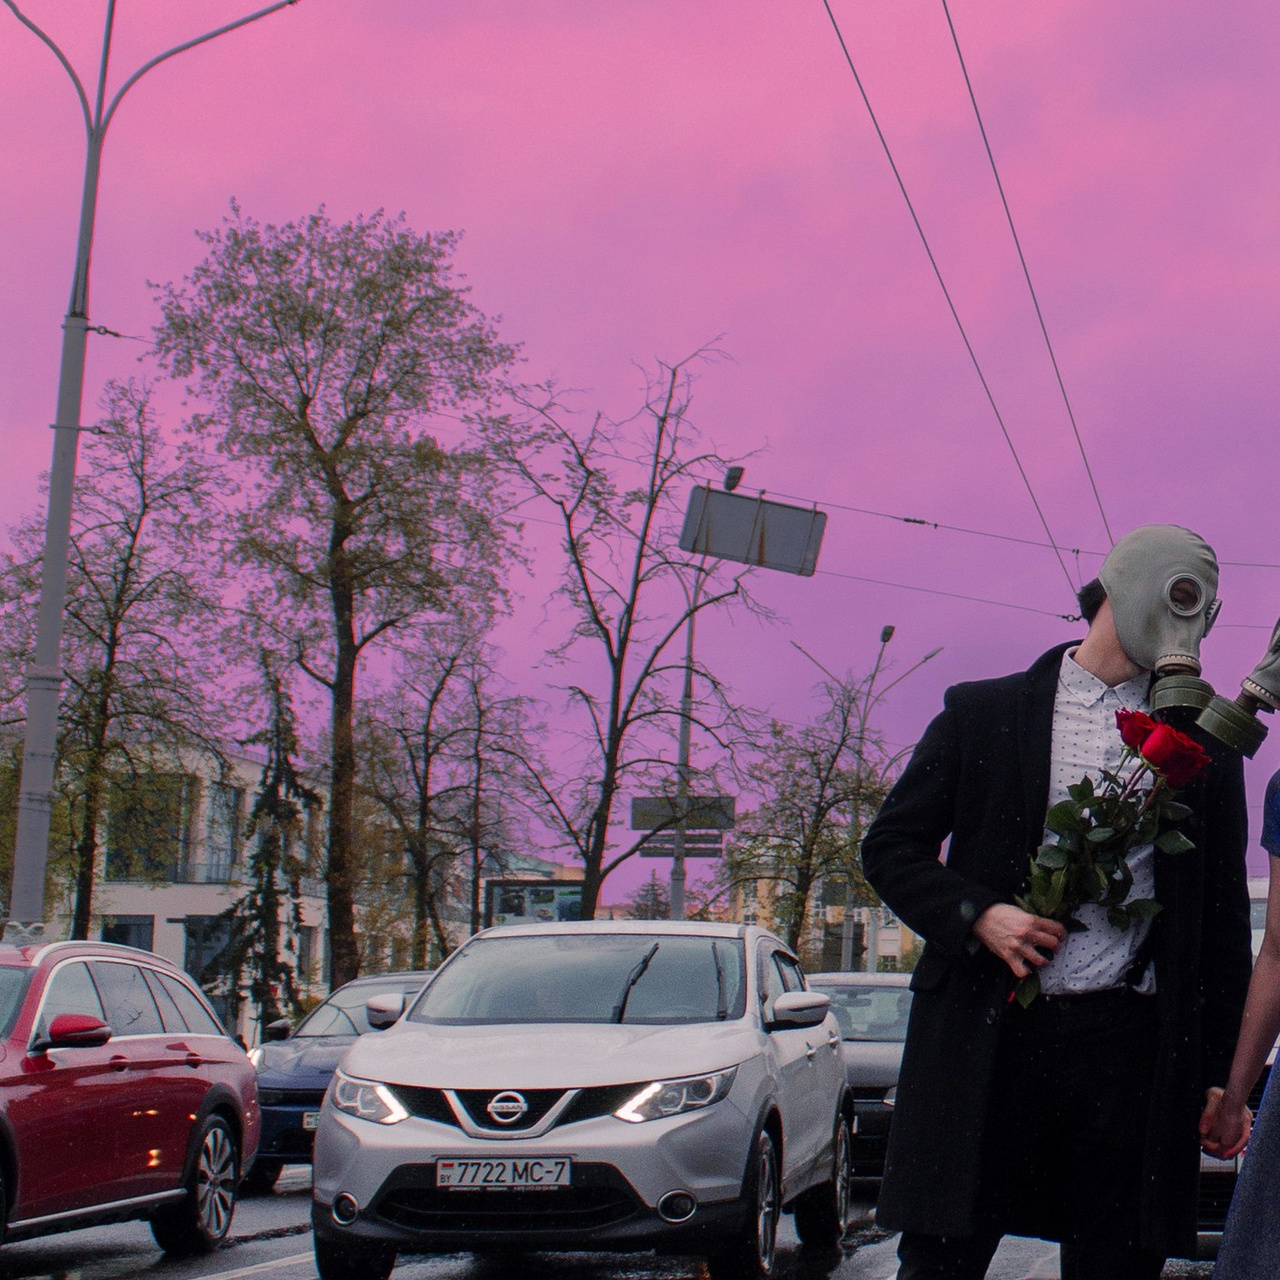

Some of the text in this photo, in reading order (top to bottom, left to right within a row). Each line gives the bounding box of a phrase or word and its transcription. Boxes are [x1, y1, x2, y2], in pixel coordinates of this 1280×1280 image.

[440, 1174, 451, 1183] BY
[457, 1161, 566, 1184] 7722 MC-7
